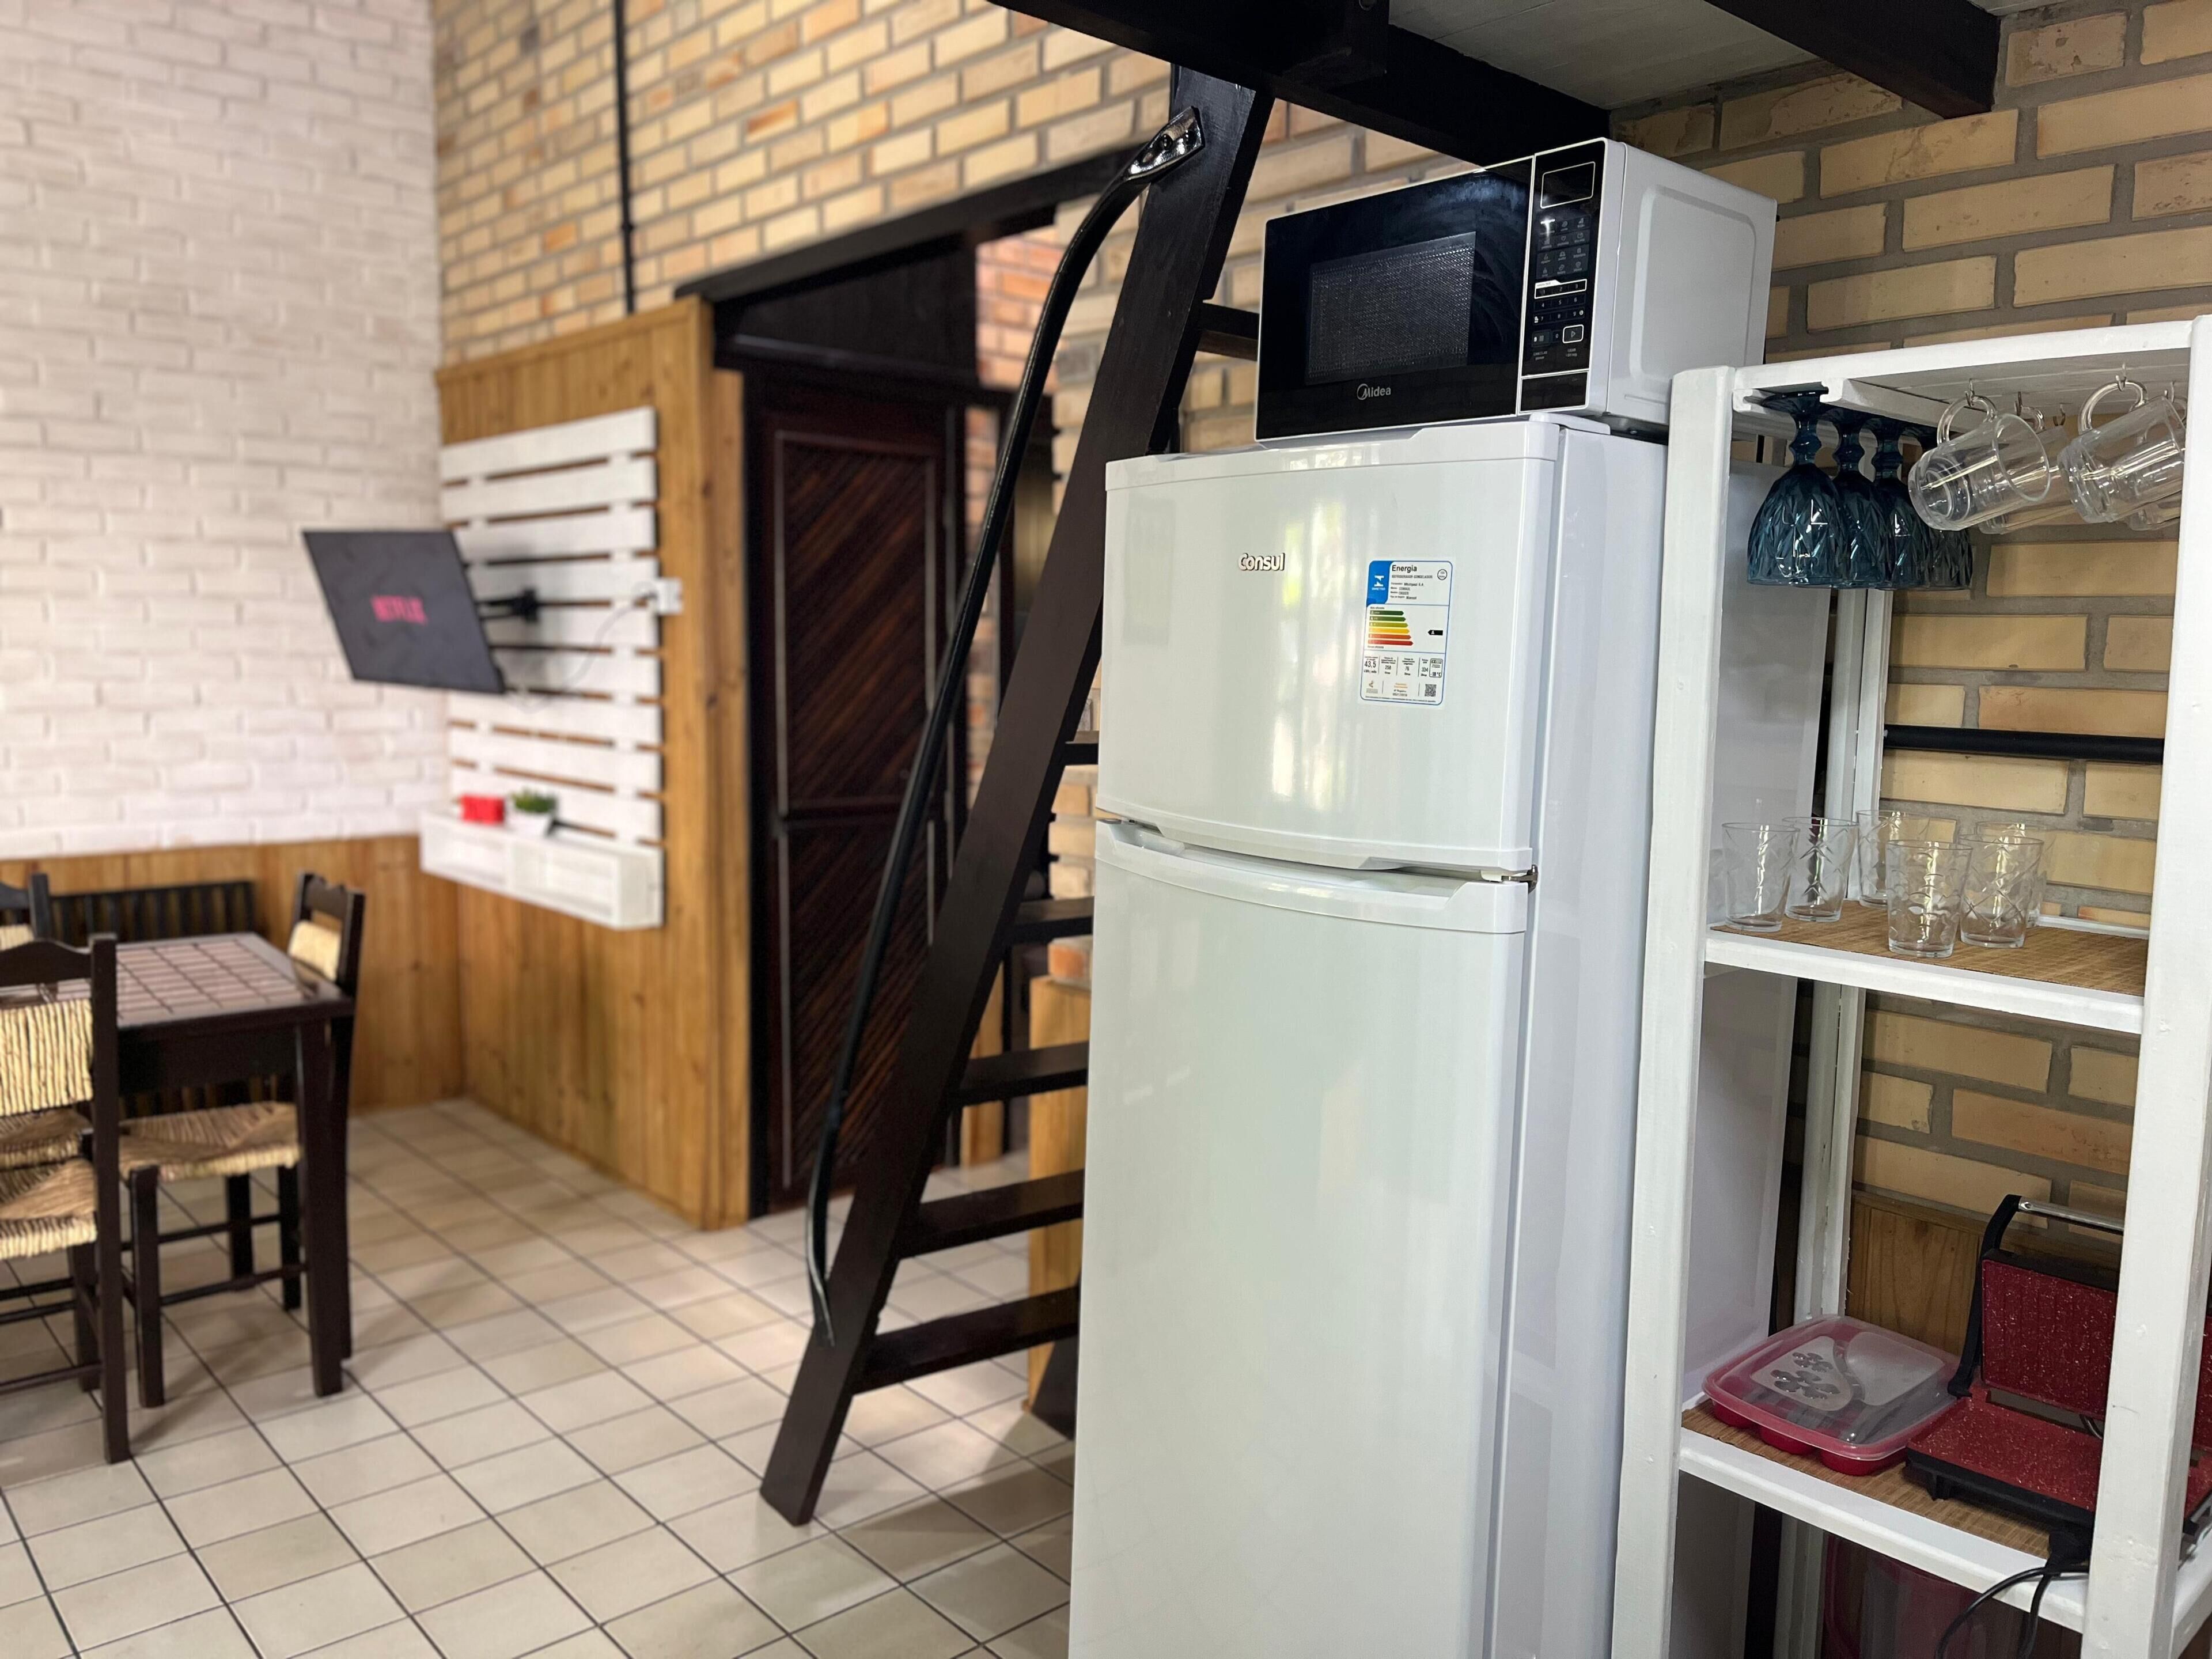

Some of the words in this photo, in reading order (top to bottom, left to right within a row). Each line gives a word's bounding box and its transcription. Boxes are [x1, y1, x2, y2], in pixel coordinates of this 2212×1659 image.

[1357, 383, 1391, 400] Midea
[1238, 552, 1285, 571] Consul
[1392, 565, 1417, 573] Energia
